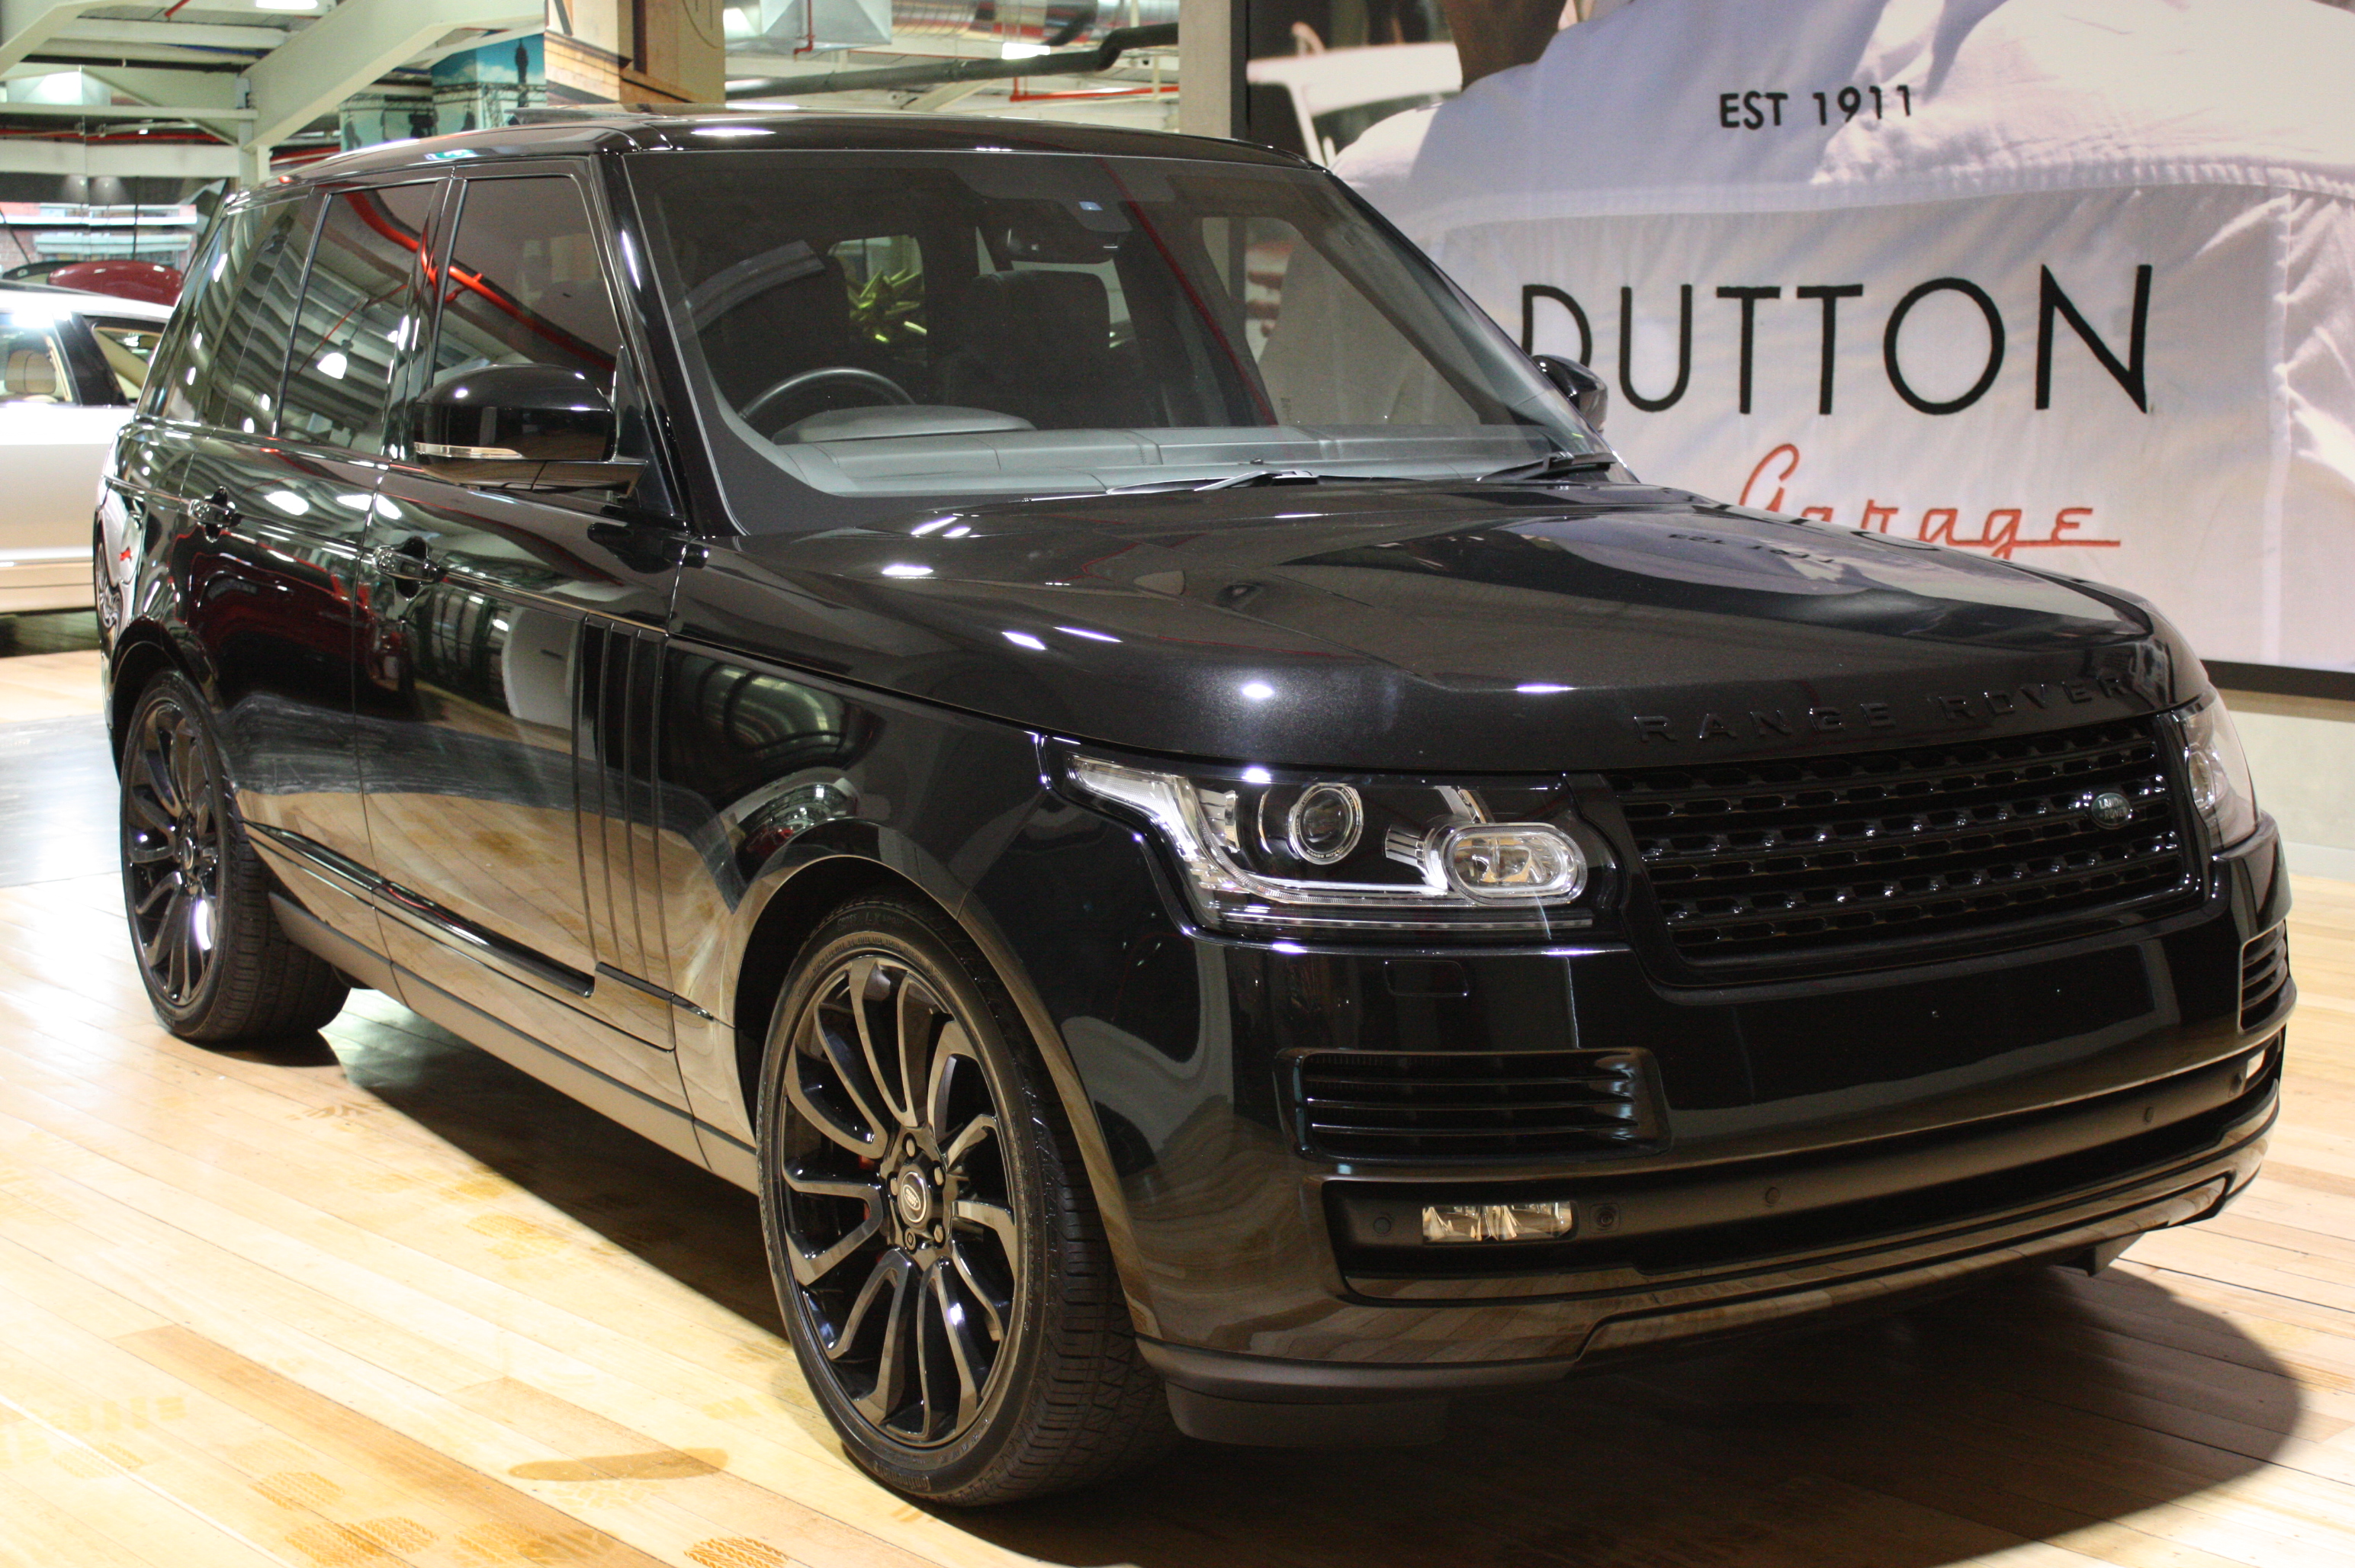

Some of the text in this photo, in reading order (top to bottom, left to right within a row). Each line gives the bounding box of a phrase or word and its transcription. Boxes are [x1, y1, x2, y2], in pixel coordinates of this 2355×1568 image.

[1720, 84, 1912, 130] EST 1911
[1522, 264, 2154, 416] DUTTON
[1634, 676, 2128, 743] RANGE ROVER
[2098, 797, 2120, 810] LAND
[1306, 849, 1325, 859] RANGE
